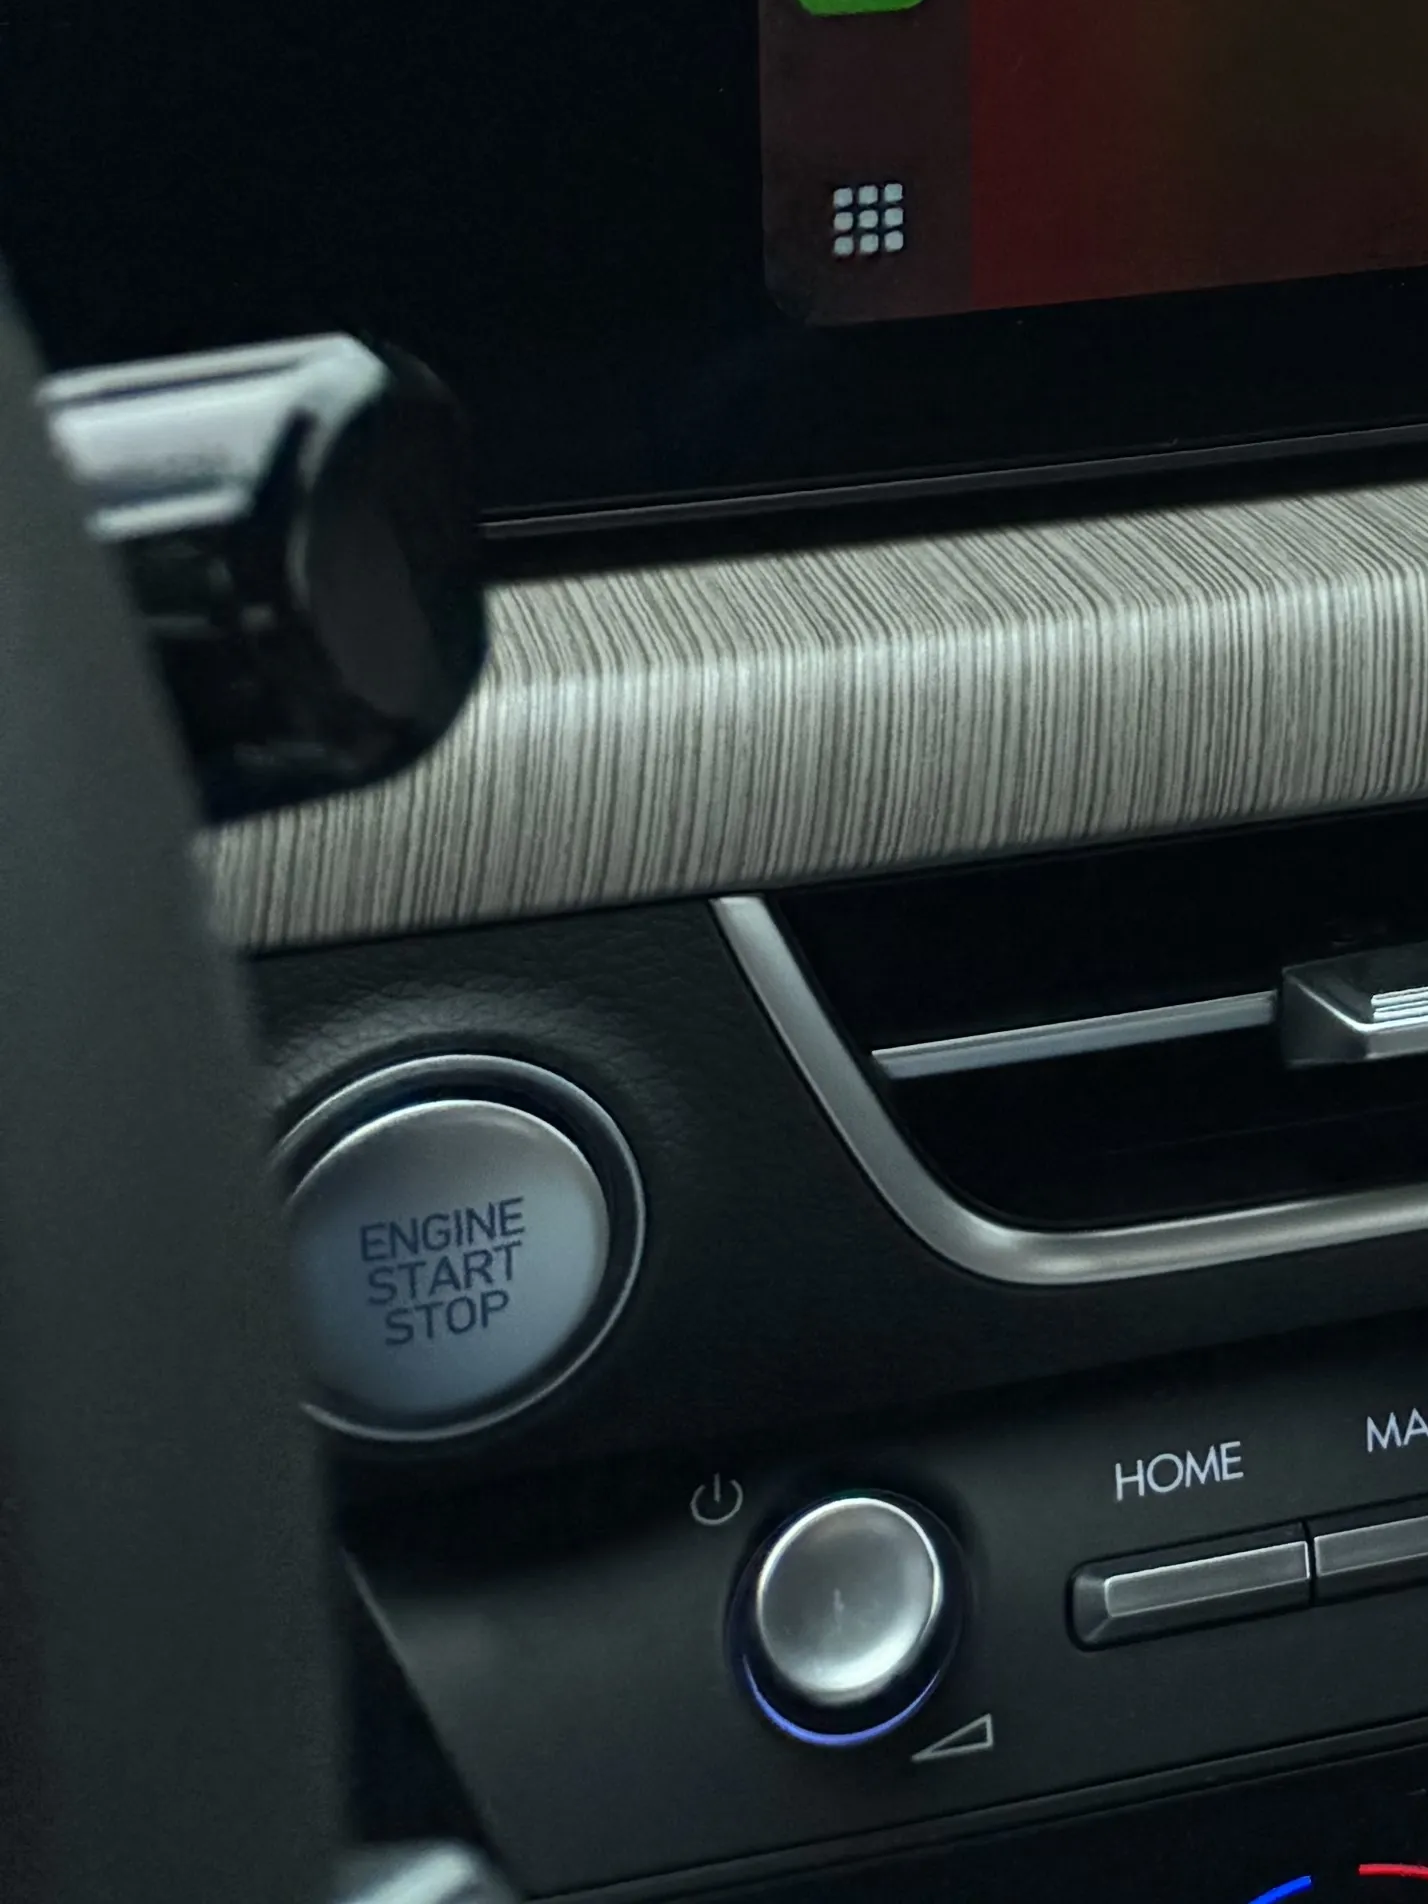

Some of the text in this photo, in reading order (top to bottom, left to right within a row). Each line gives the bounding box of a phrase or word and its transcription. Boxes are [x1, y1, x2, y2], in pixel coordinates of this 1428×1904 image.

[361, 1196, 525, 1262] ENGINE
[366, 1241, 523, 1307] START
[384, 1289, 510, 1347] STOP
[1115, 1440, 1244, 1502] HOME
